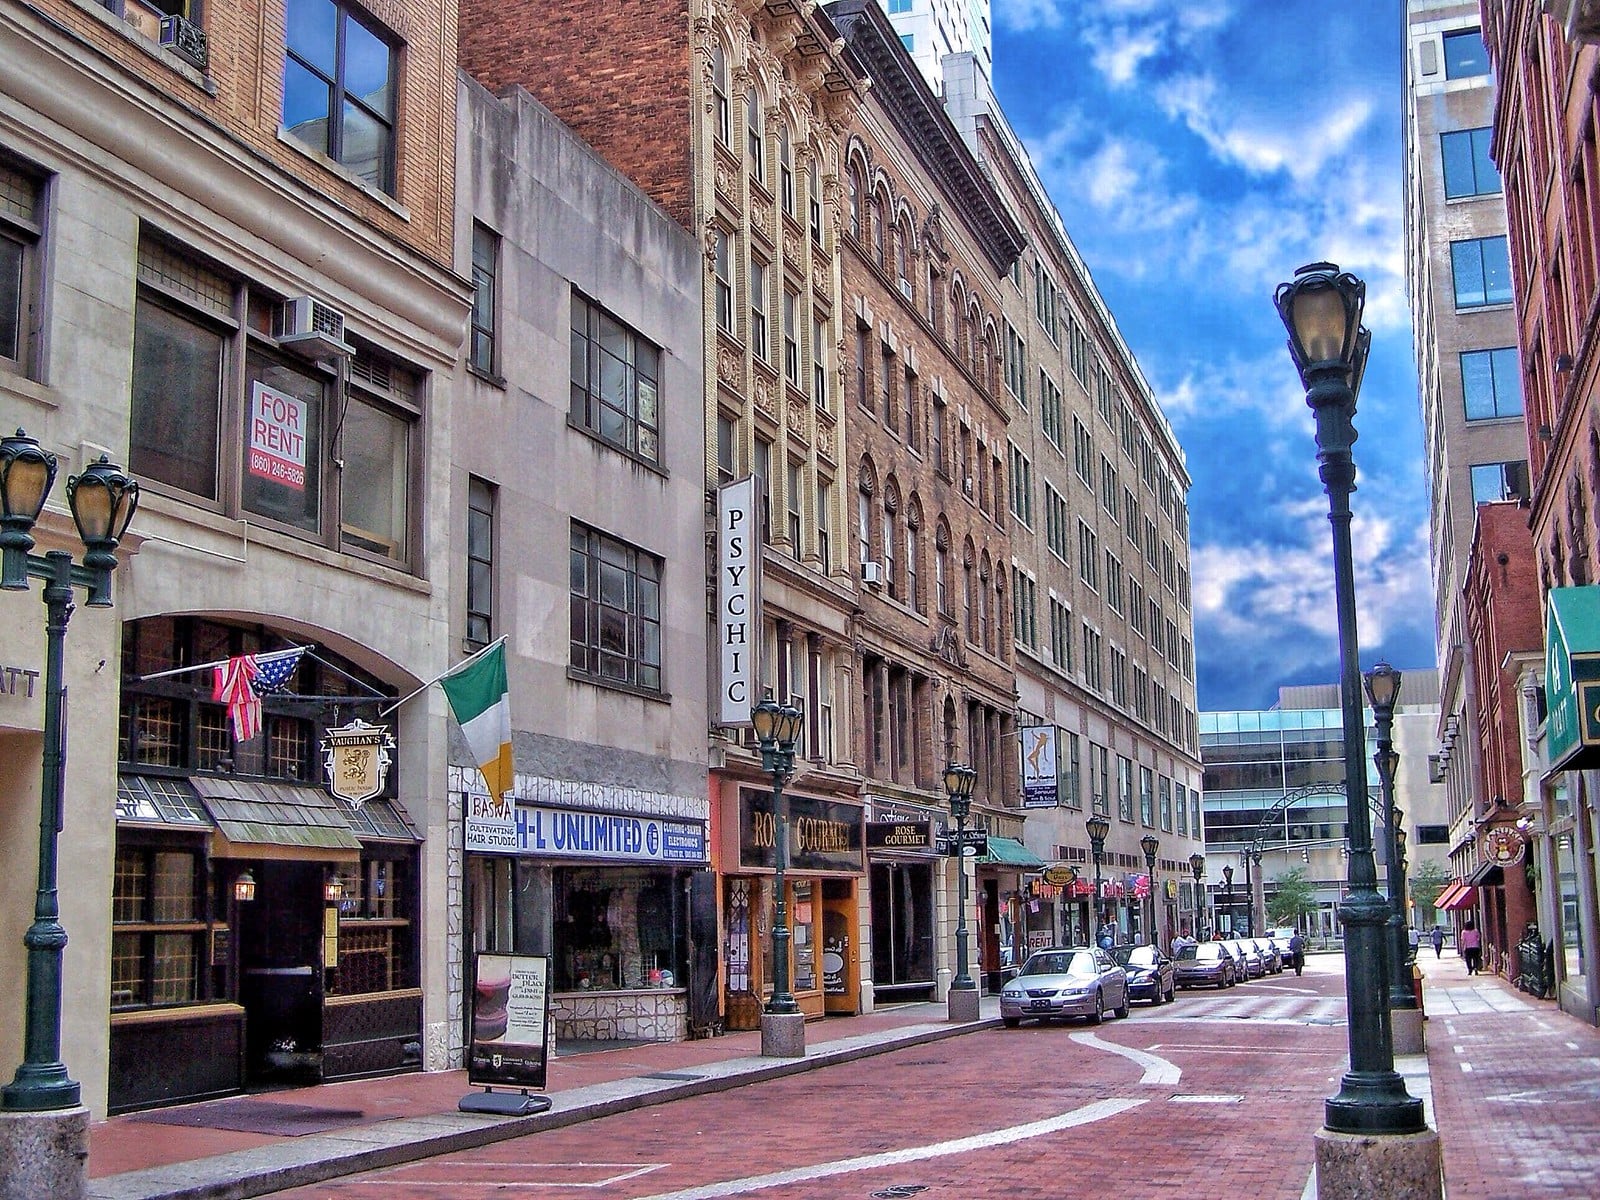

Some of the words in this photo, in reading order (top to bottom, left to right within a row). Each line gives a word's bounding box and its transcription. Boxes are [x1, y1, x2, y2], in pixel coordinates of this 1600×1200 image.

[261, 391, 299, 430] FOR
[255, 418, 304, 459] RENT
[725, 509, 746, 704] PSYCHIC
[330, 735, 381, 746] VAUGHAN'S
[469, 824, 515, 835] CULTIVATING
[552, 812, 642, 853] UNLIMITED
[797, 816, 850, 852] GOURMET
[894, 825, 916, 835] ROSE
[467, 832, 486, 844] HAIR
[884, 834, 926, 845] GOURMET
[1029, 936, 1052, 948] RENT
